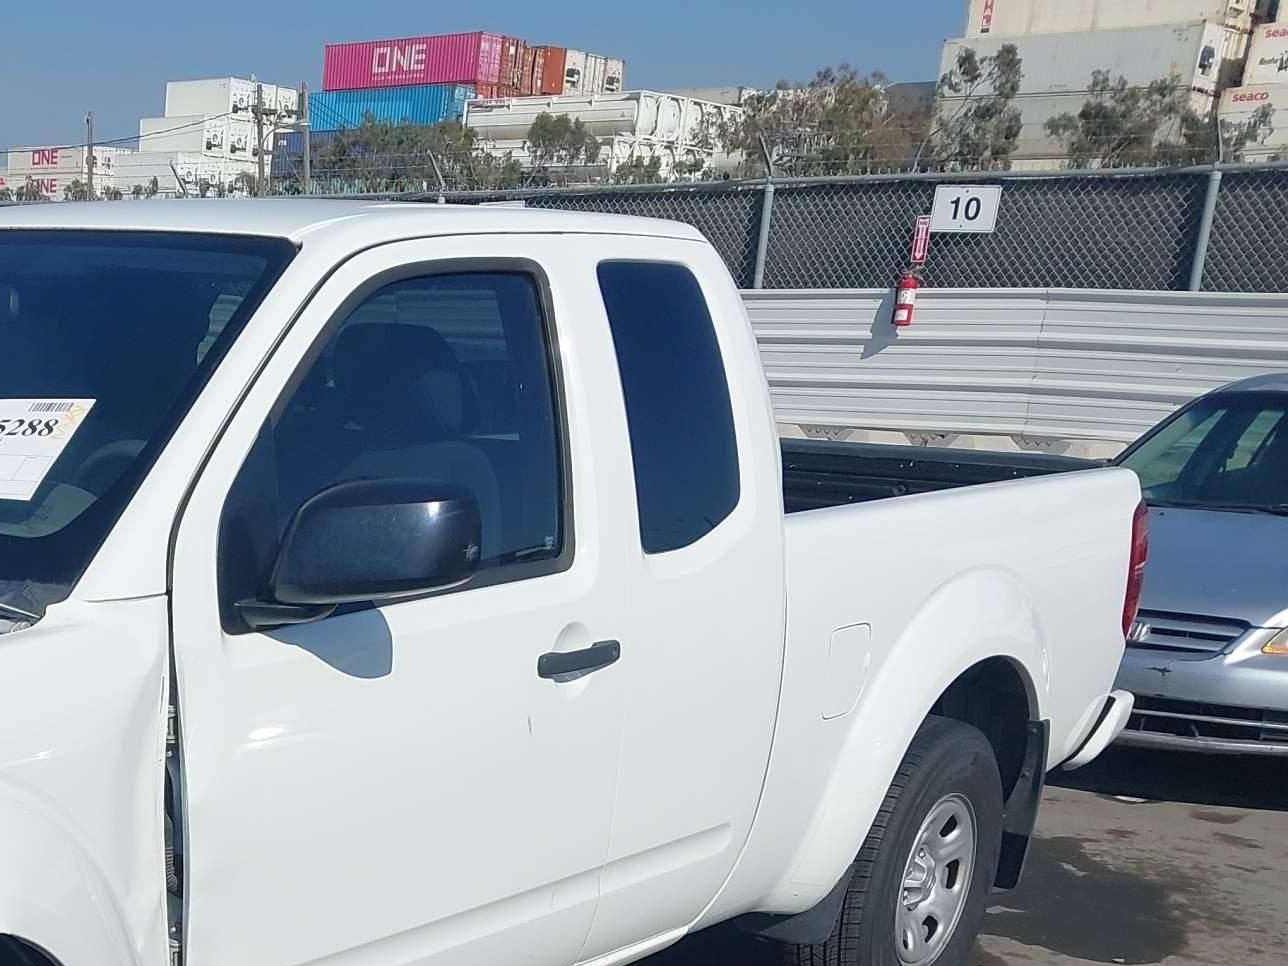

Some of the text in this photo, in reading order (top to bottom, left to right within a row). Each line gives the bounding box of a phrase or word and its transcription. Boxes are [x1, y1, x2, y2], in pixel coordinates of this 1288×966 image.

[372, 44, 426, 73] ONE
[1232, 92, 1269, 102] seaco
[32, 149, 58, 166] ONE
[950, 196, 981, 221] 10
